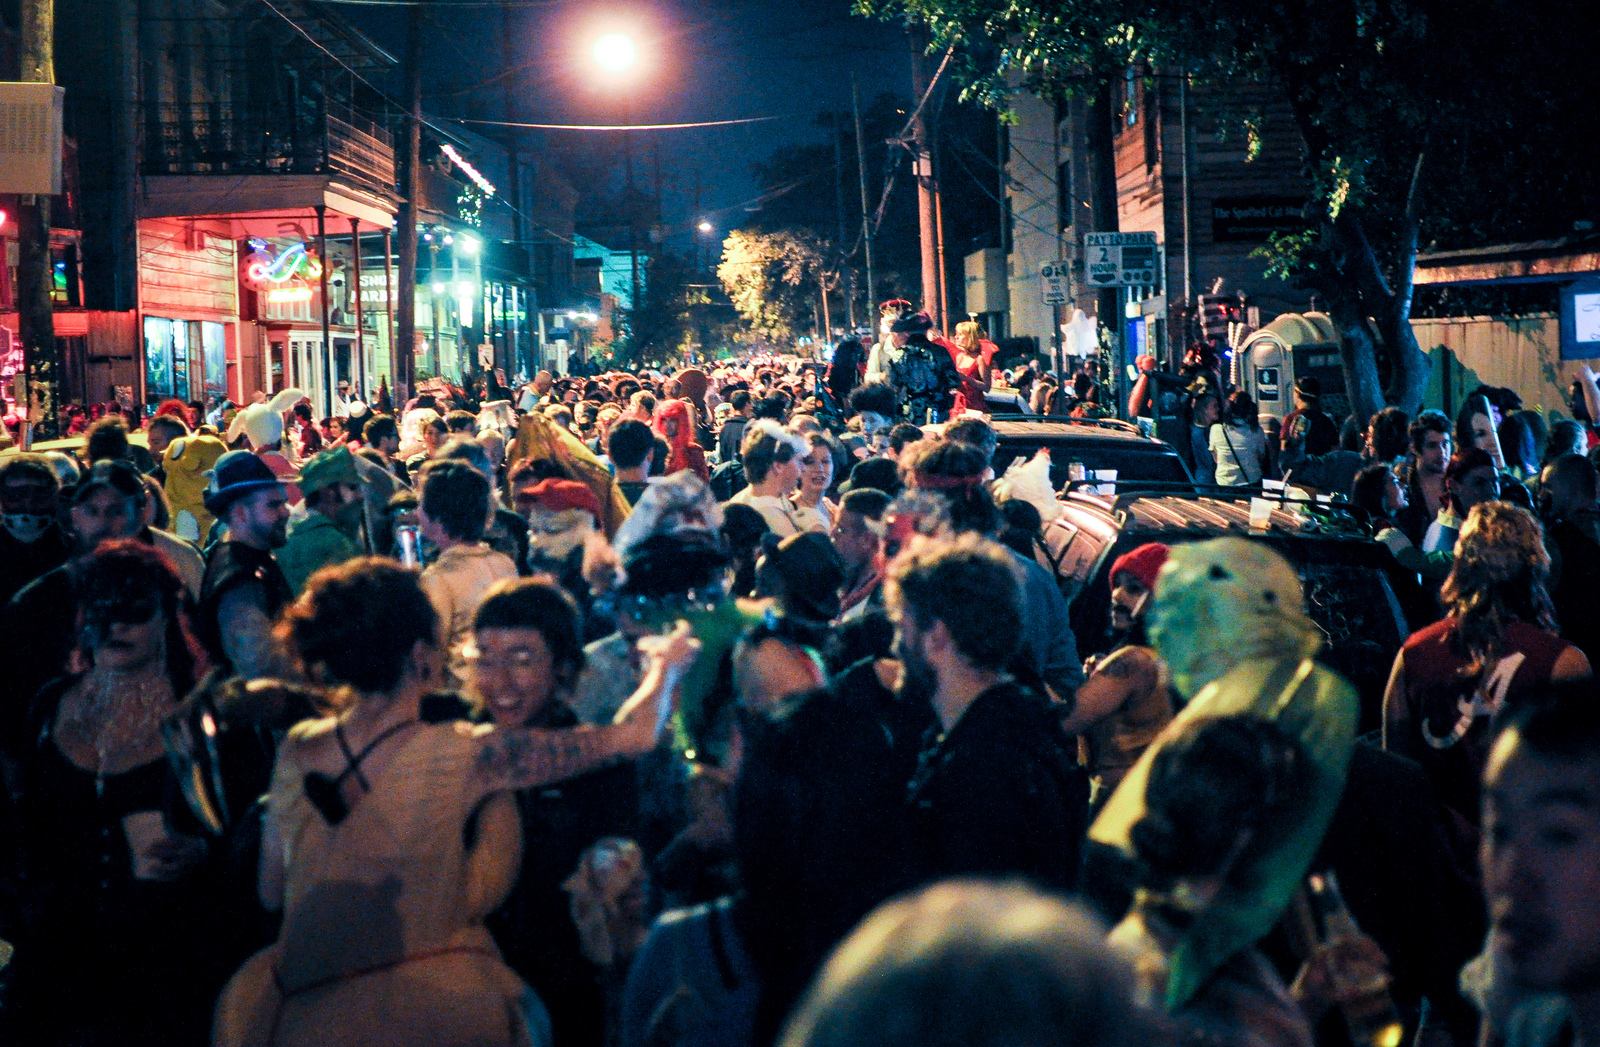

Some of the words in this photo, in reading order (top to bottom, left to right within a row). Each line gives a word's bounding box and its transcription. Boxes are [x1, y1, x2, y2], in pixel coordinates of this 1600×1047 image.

[1087, 234, 1106, 245] PAY
[1110, 234, 1124, 245] TO
[1126, 233, 1154, 244] PARK
[1099, 247, 1109, 262] 2
[1090, 263, 1118, 273] HOUR
